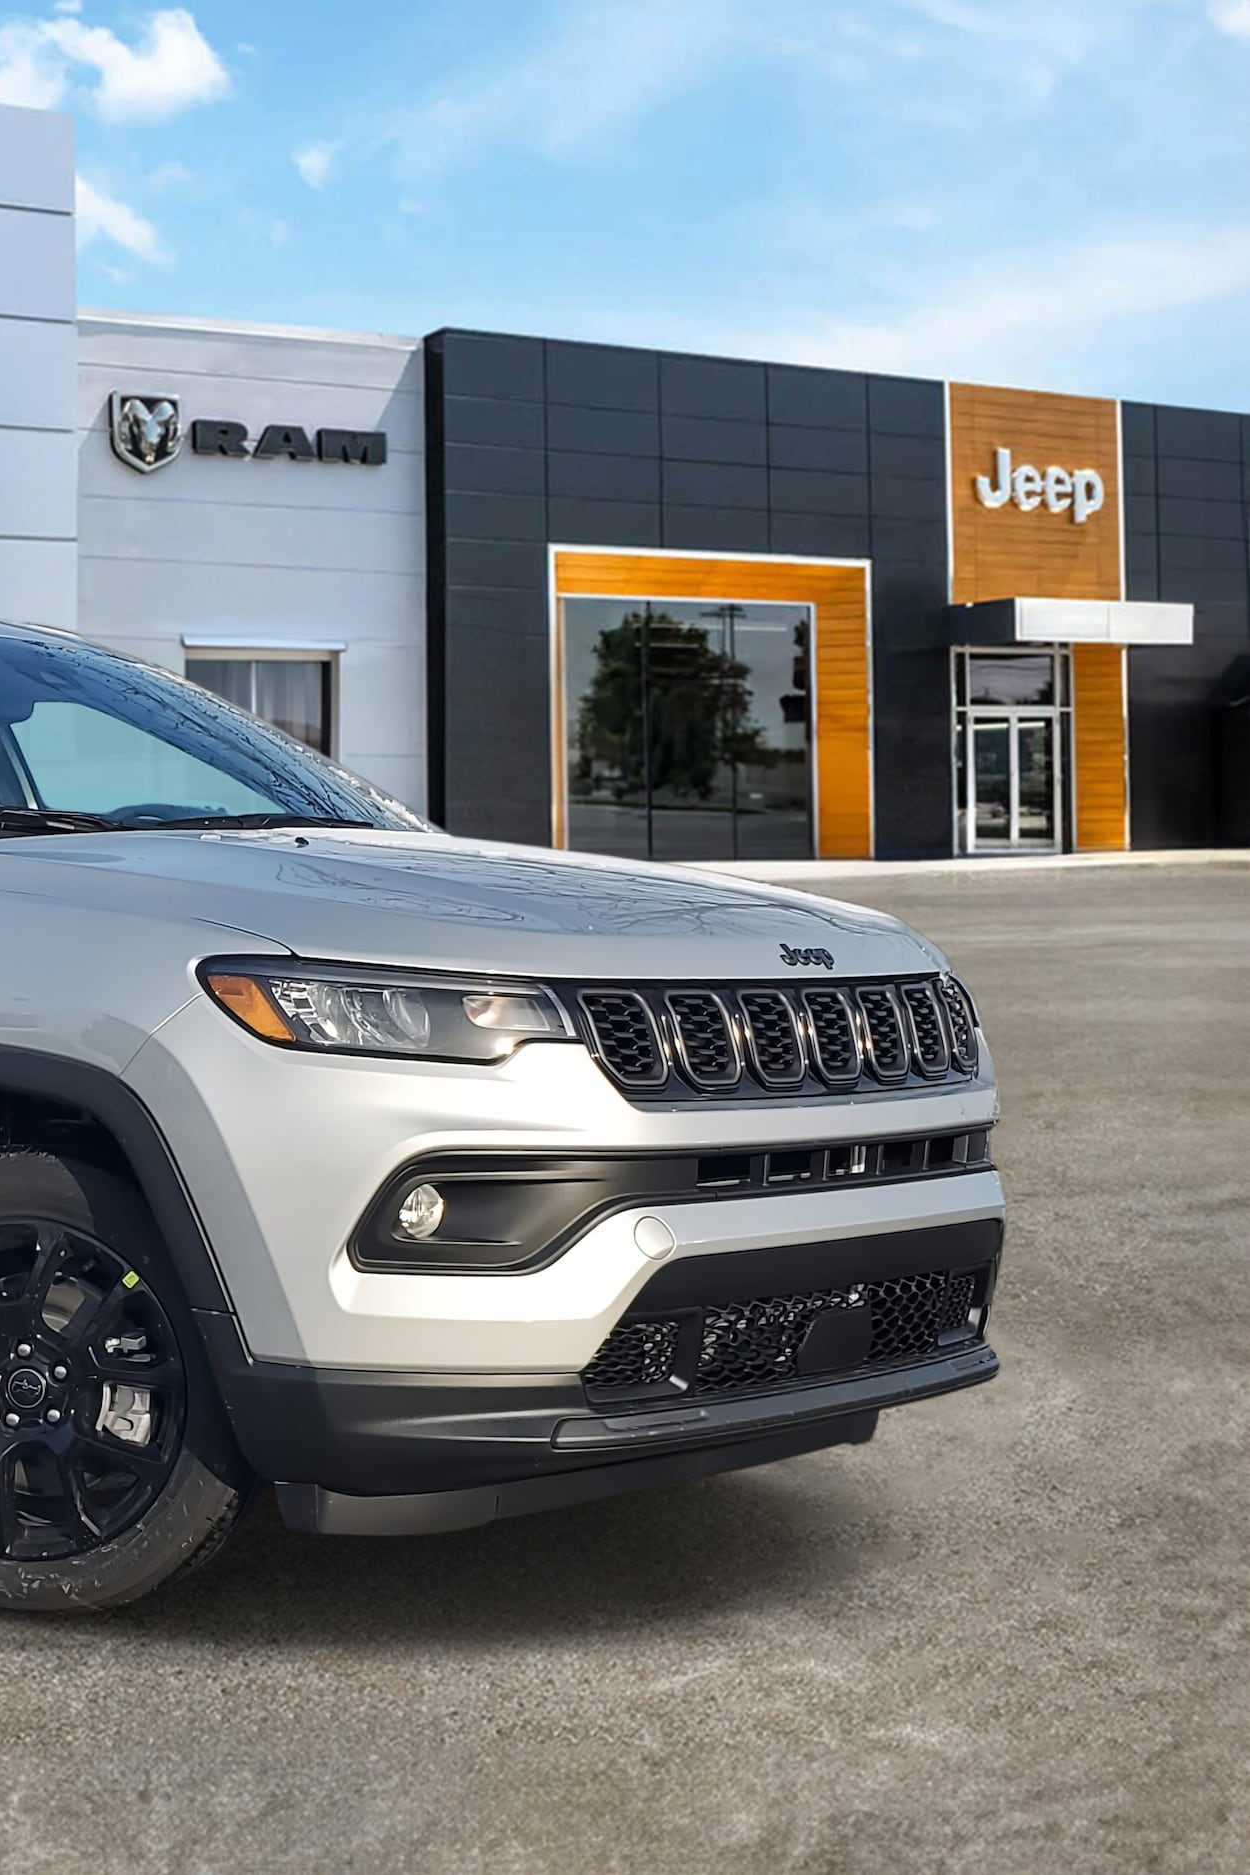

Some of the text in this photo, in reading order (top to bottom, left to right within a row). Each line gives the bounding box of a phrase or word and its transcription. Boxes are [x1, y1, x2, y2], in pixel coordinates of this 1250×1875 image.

[191, 419, 387, 465] RAM
[976, 447, 1104, 524] Jeep
[779, 943, 835, 970] Jeep
